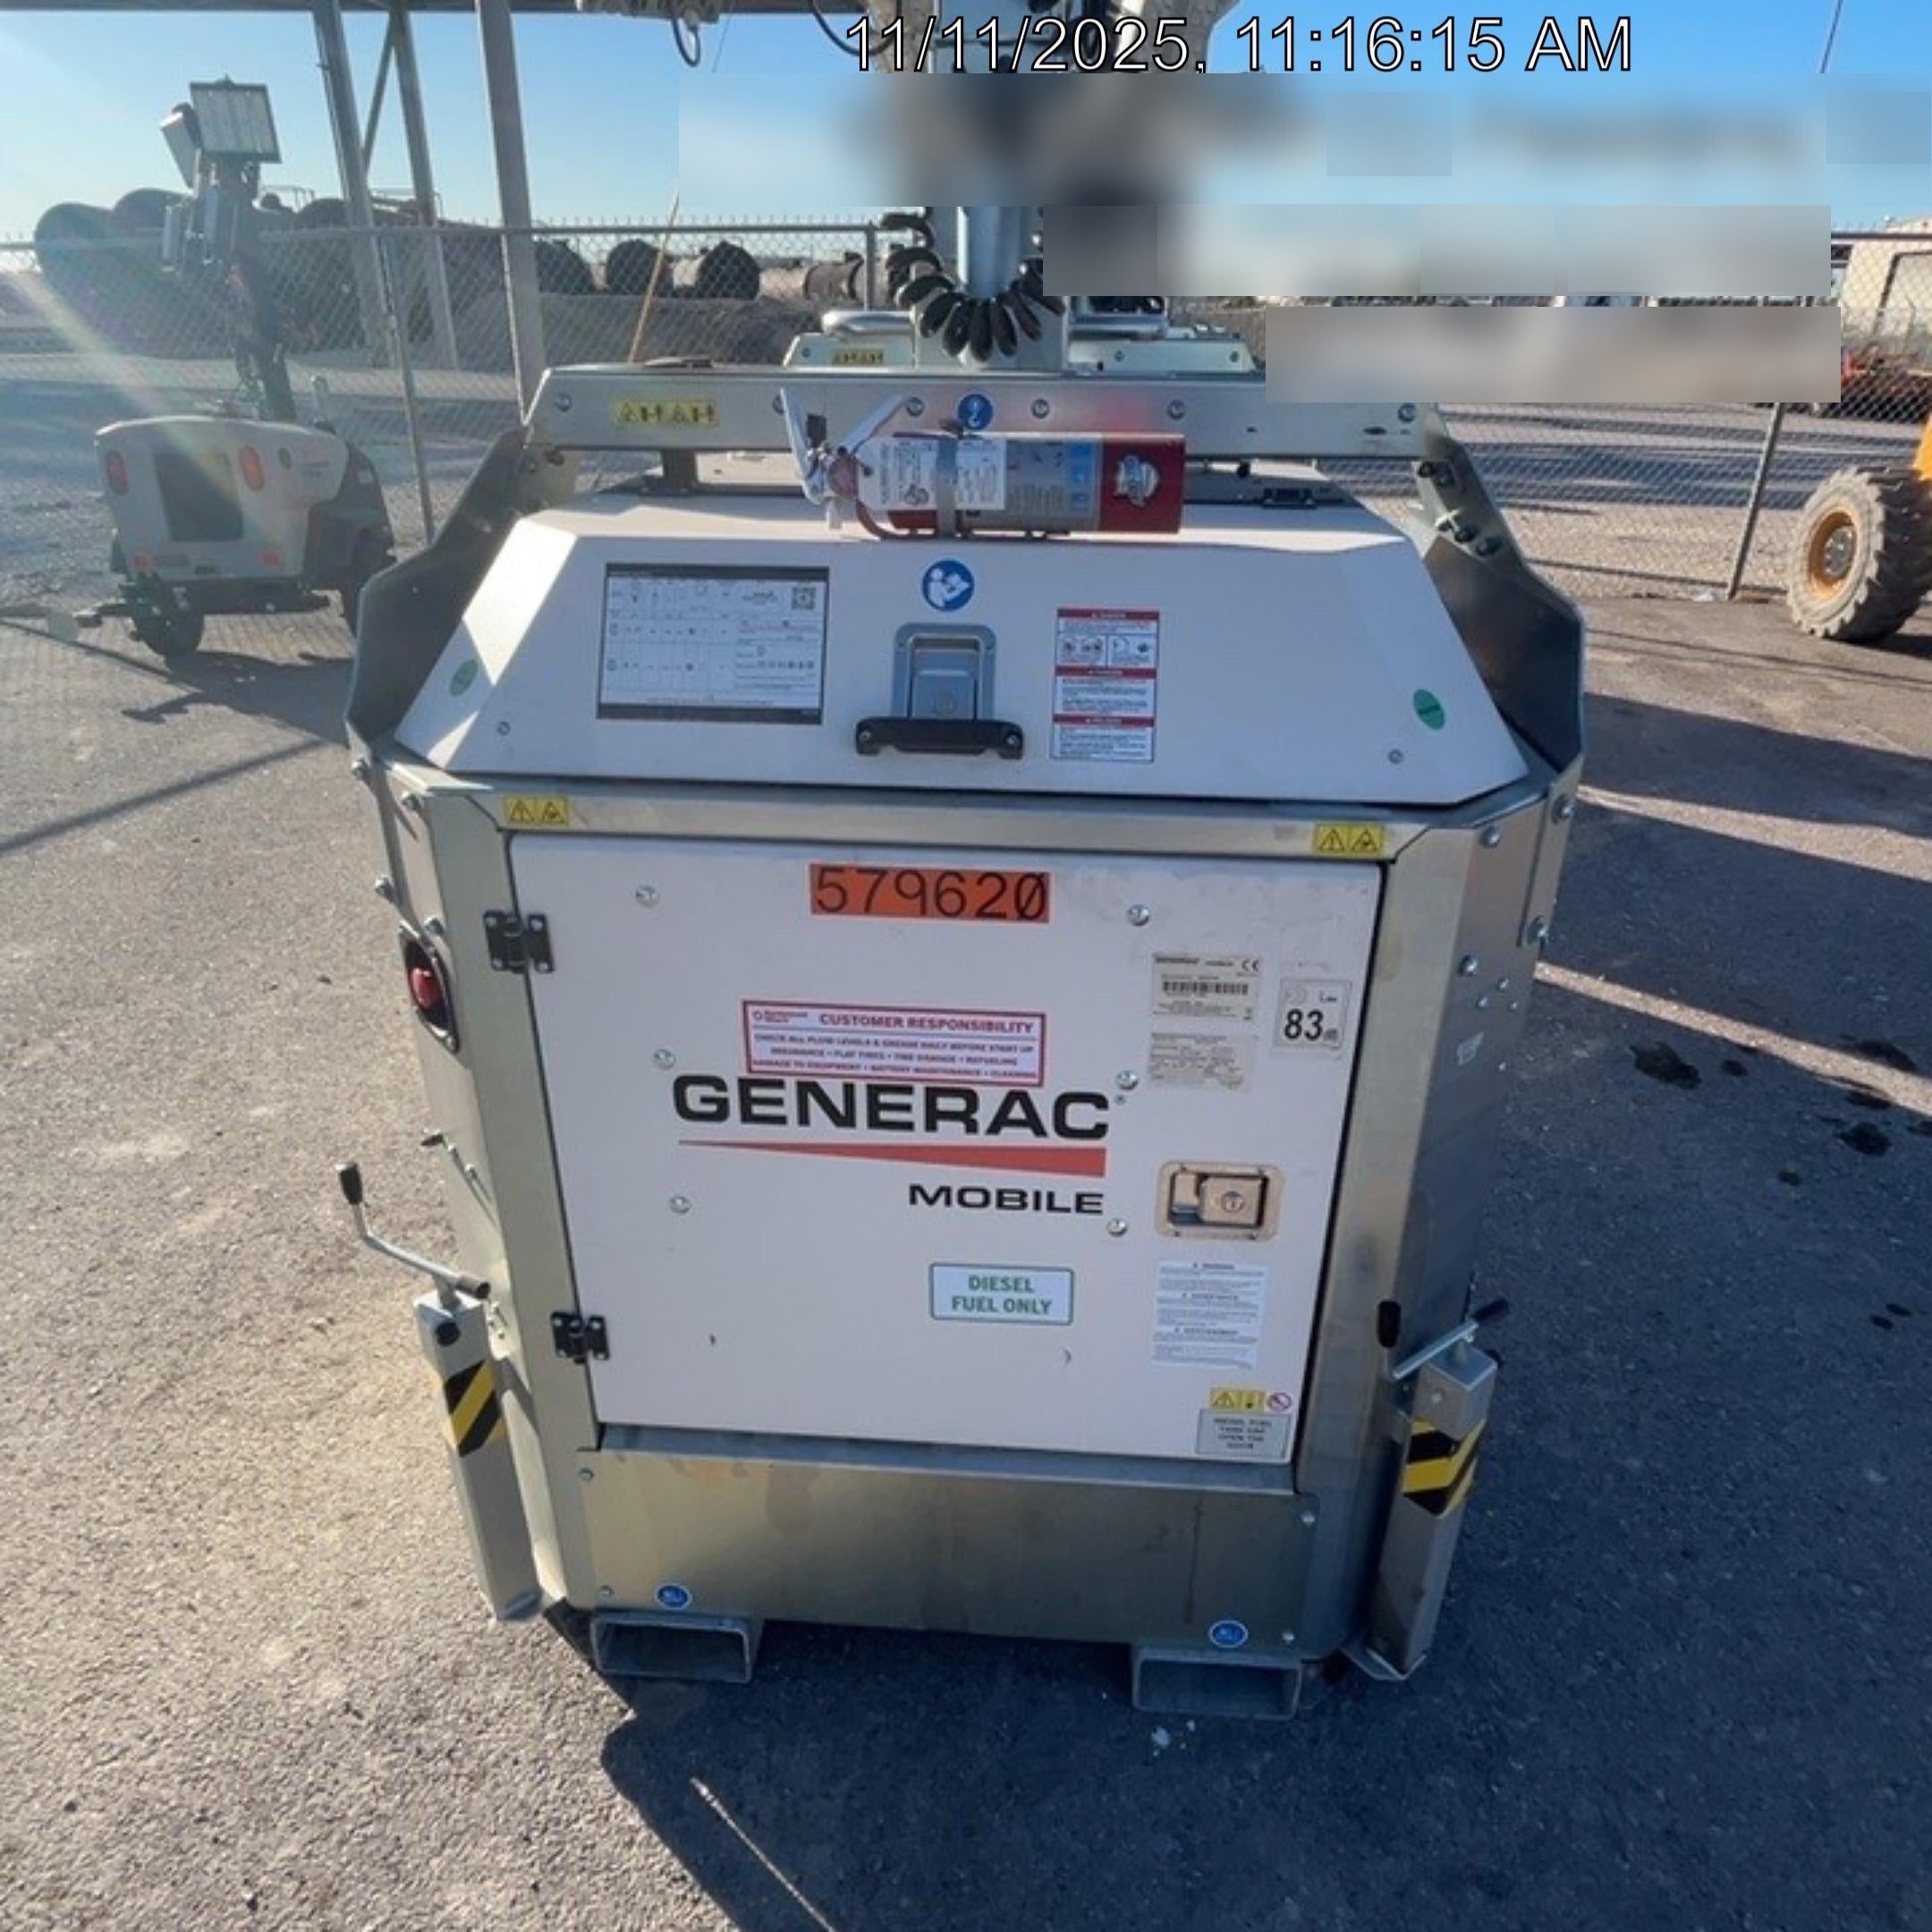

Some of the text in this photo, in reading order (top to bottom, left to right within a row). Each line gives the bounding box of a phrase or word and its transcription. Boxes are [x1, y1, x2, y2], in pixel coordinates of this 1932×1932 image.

[817, 866, 1046, 921] 579620
[819, 1013, 903, 1029] CUSTOMER
[907, 1016, 1034, 1033] RESPONSIBILITY
[1284, 1008, 1324, 1042] 83
[672, 1074, 1110, 1140] GENERAC
[909, 1184, 1105, 1215] MOBILE
[968, 1275, 1035, 1293] DIESEL
[951, 1295, 1053, 1315] FUEL ONLY
